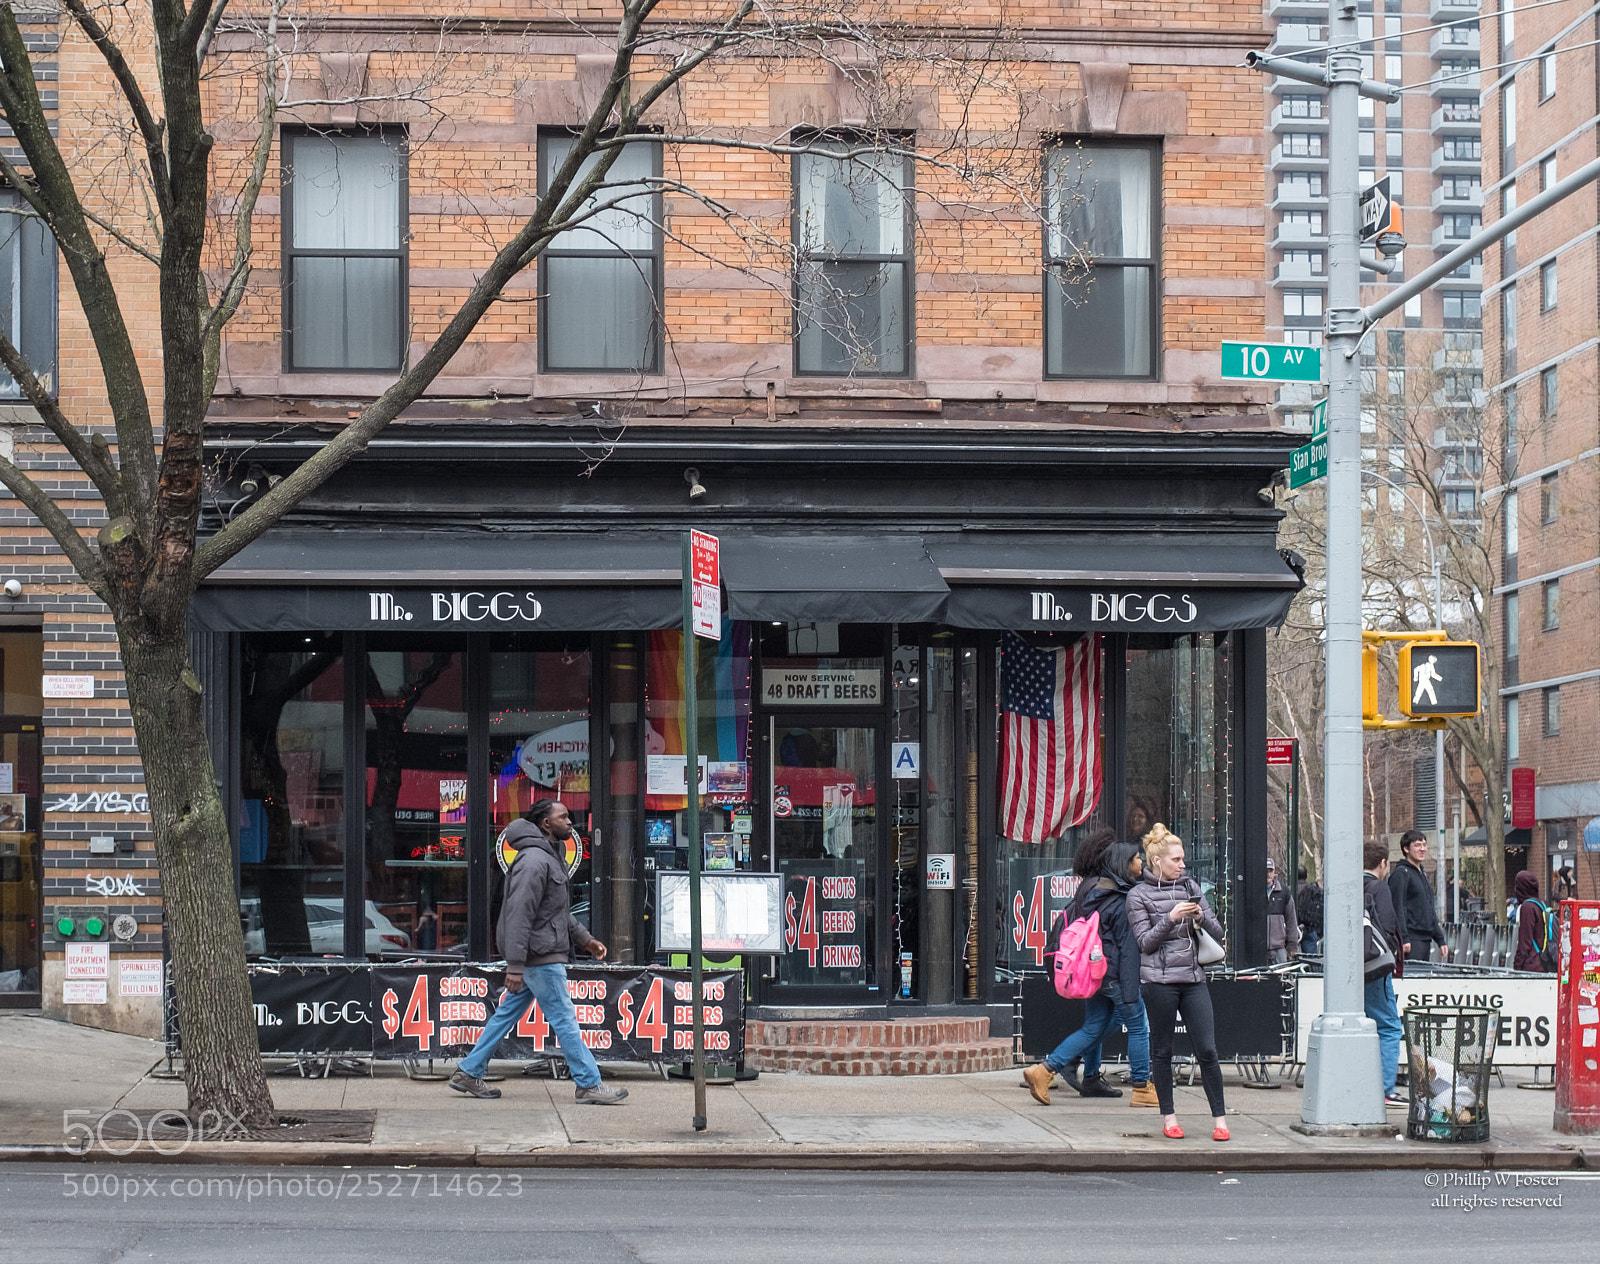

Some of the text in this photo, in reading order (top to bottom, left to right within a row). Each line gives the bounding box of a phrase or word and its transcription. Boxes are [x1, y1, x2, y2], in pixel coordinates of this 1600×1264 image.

[1365, 197, 1382, 223] WAY
[1241, 347, 1304, 376] 10 AV
[1314, 406, 1322, 434] W
[1293, 451, 1309, 472] Stan
[1310, 466, 1318, 477] Way
[693, 535, 717, 553] NO STANDING
[693, 583, 702, 605] NO
[430, 592, 542, 621] BIGGS
[1090, 593, 1197, 622] BIGGS
[785, 674, 855, 682] NOW SERVING
[767, 684, 877, 699] 48 DRAFT BEERS
[896, 747, 915, 768] A
[927, 872, 949, 880] WiFi
[822, 876, 856, 899] SHOTS
[785, 876, 819, 967] $4
[823, 911, 855, 933] BEERS
[1013, 876, 1047, 966] $4
[69, 956, 106, 964] DEPARTMENT
[81, 946, 94, 954] FIRE
[823, 945, 861, 967] DRINKS
[70, 966, 105, 974] CONNECTION
[121, 963, 160, 971] SPRINKLERS
[439, 977, 488, 997] SHOTS
[566, 980, 606, 1000] HOTS
[674, 981, 725, 1001] SHTS
[1407, 994, 1504, 1008] SERVING
[382, 974, 434, 1051] $4
[439, 1002, 487, 1021] BEERS
[574, 1005, 605, 1024] ERS
[617, 977, 668, 1053] $4
[674, 1005, 723, 1025] BERS
[673, 1030, 730, 1050] DRNKS
